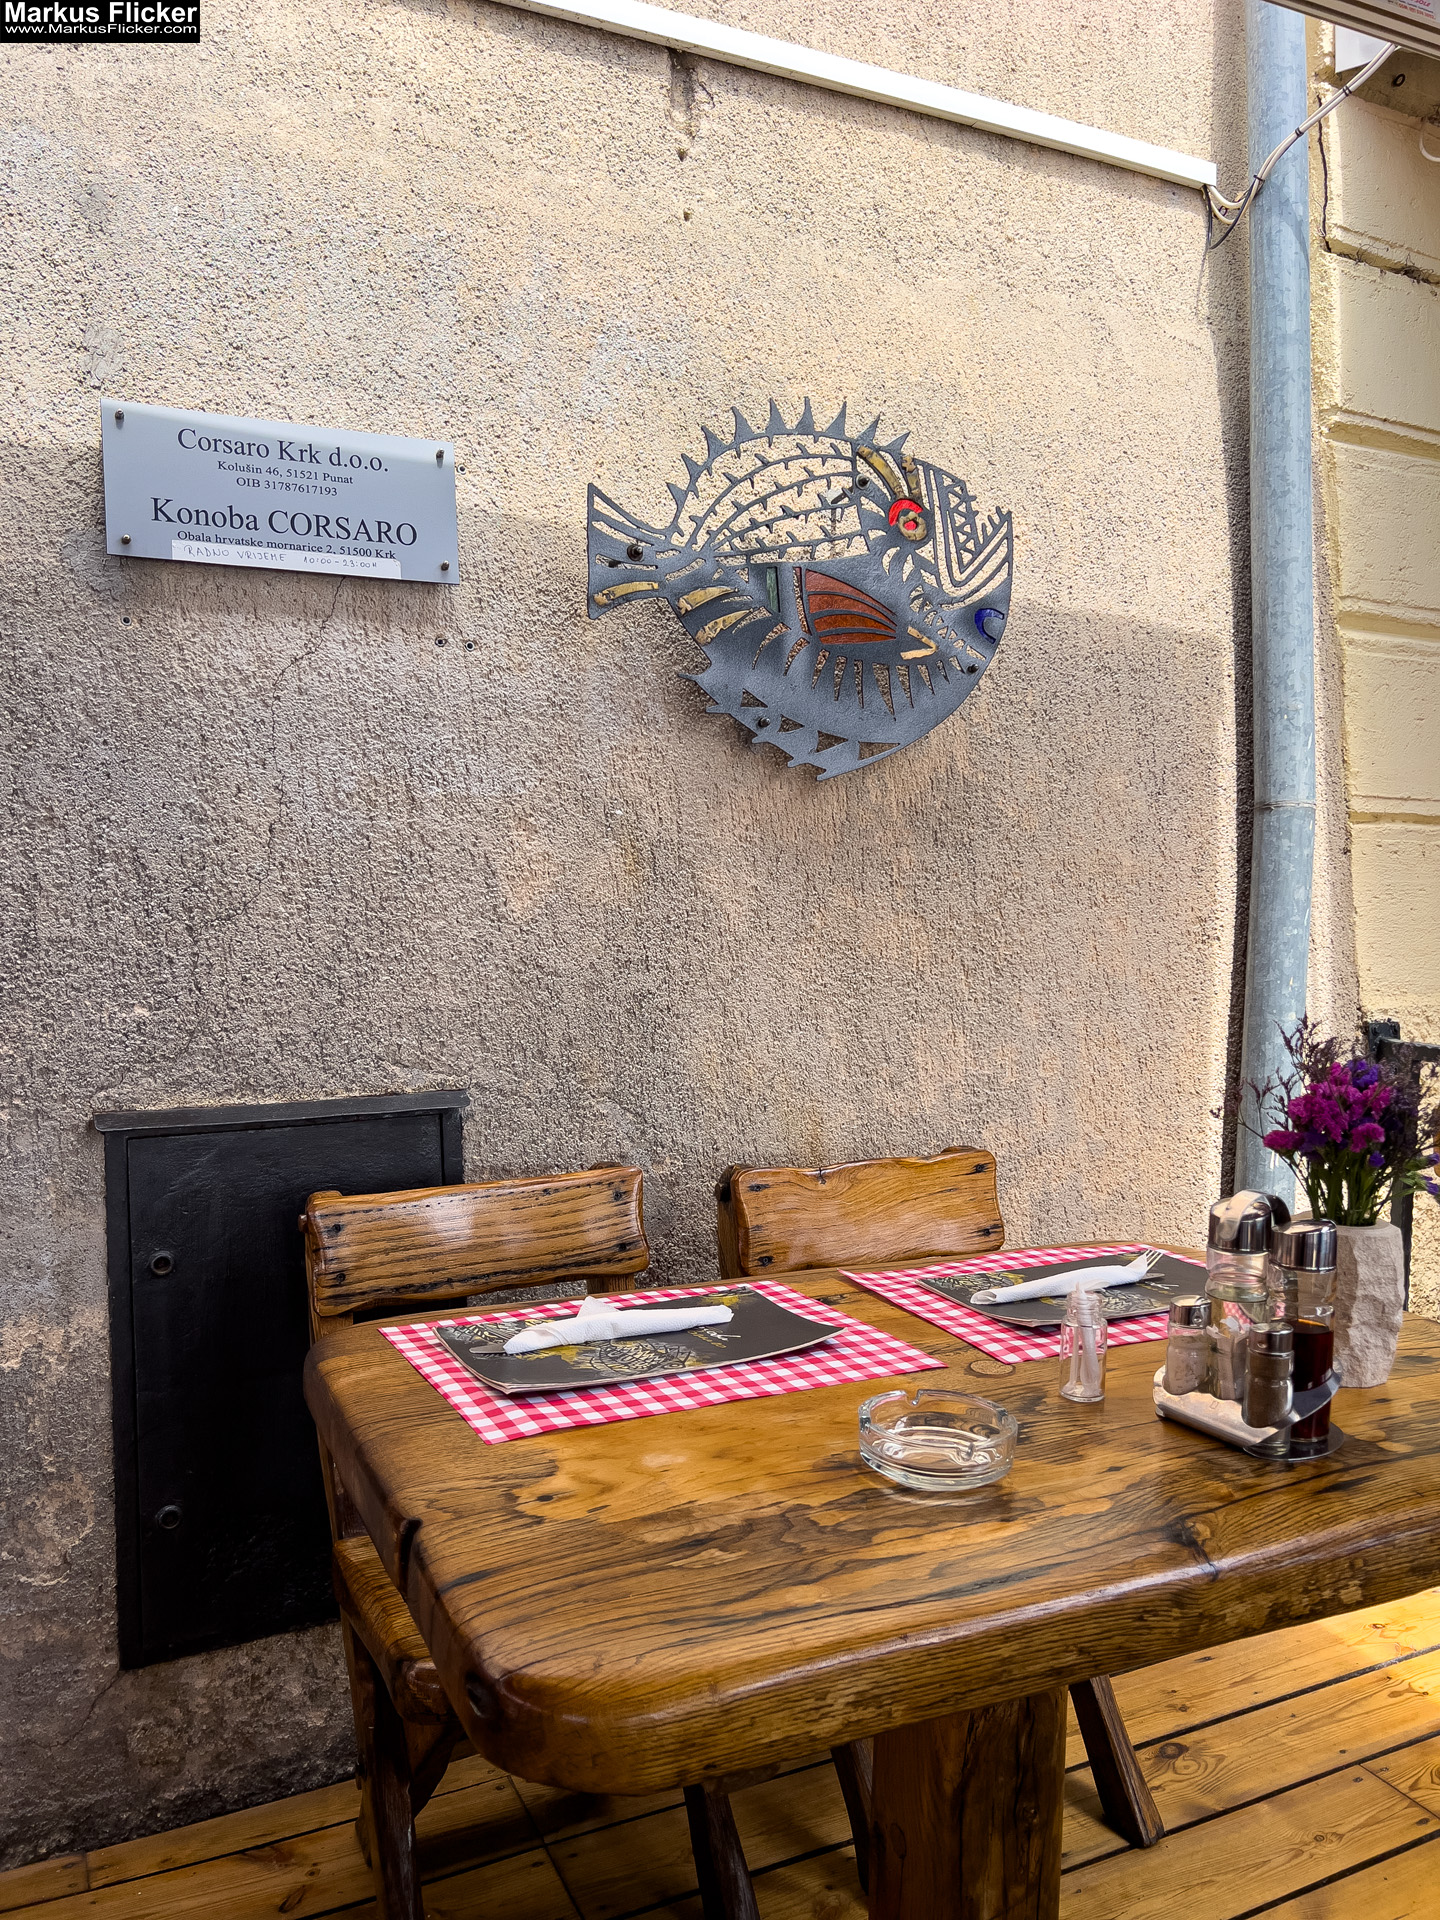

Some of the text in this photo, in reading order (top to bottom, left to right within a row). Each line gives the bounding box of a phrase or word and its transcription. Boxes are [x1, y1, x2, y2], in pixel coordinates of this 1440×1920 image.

[177, 428, 389, 472] Corsaro Krk d.o.o.
[217, 460, 353, 485] Kolušin 46, 51521 Punat
[236, 476, 338, 497] OIB 31787617193
[150, 496, 418, 546] Konoba CORSARO
[177, 530, 212, 543] Obala
[215, 533, 263, 548] hrvatske
[266, 541, 323, 553] mornarice
[340, 546, 372, 558] 51500
[375, 549, 396, 560] Krk
[183, 544, 230, 558] RADNO
[236, 550, 287, 562] VRIJEME
